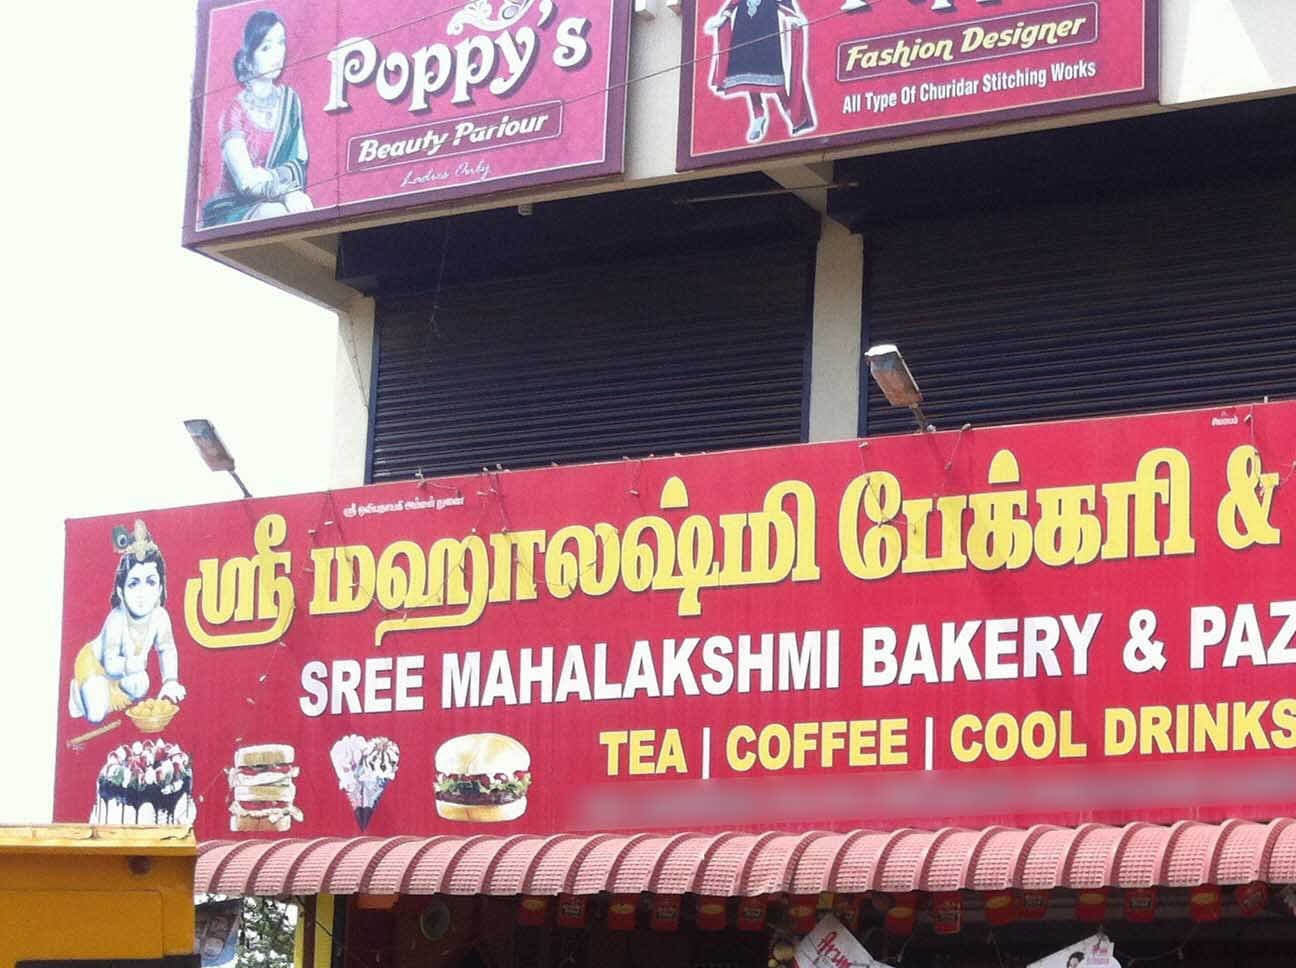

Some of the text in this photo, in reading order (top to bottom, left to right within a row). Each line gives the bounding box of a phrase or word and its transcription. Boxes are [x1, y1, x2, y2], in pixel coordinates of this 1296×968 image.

[323, 0, 590, 112] Poppy's
[845, 17, 1087, 71] Fashion Designer
[843, 60, 1096, 113] All Type Of Churidar Stitching Works
[357, 131, 448, 163] Beauty
[308, 475, 820, 647] மஹாலஷ்மி
[839, 447, 1195, 580] பேக்கரி
[1217, 444, 1281, 550] &
[299, 655, 425, 717] SREE
[440, 629, 840, 708] MAHALAKSHMI
[862, 612, 1103, 687] BAKERY
[1122, 608, 1168, 673] &
[599, 728, 689, 776] TEA
[726, 718, 909, 773] COFFEE
[950, 709, 1088, 763] COOL
